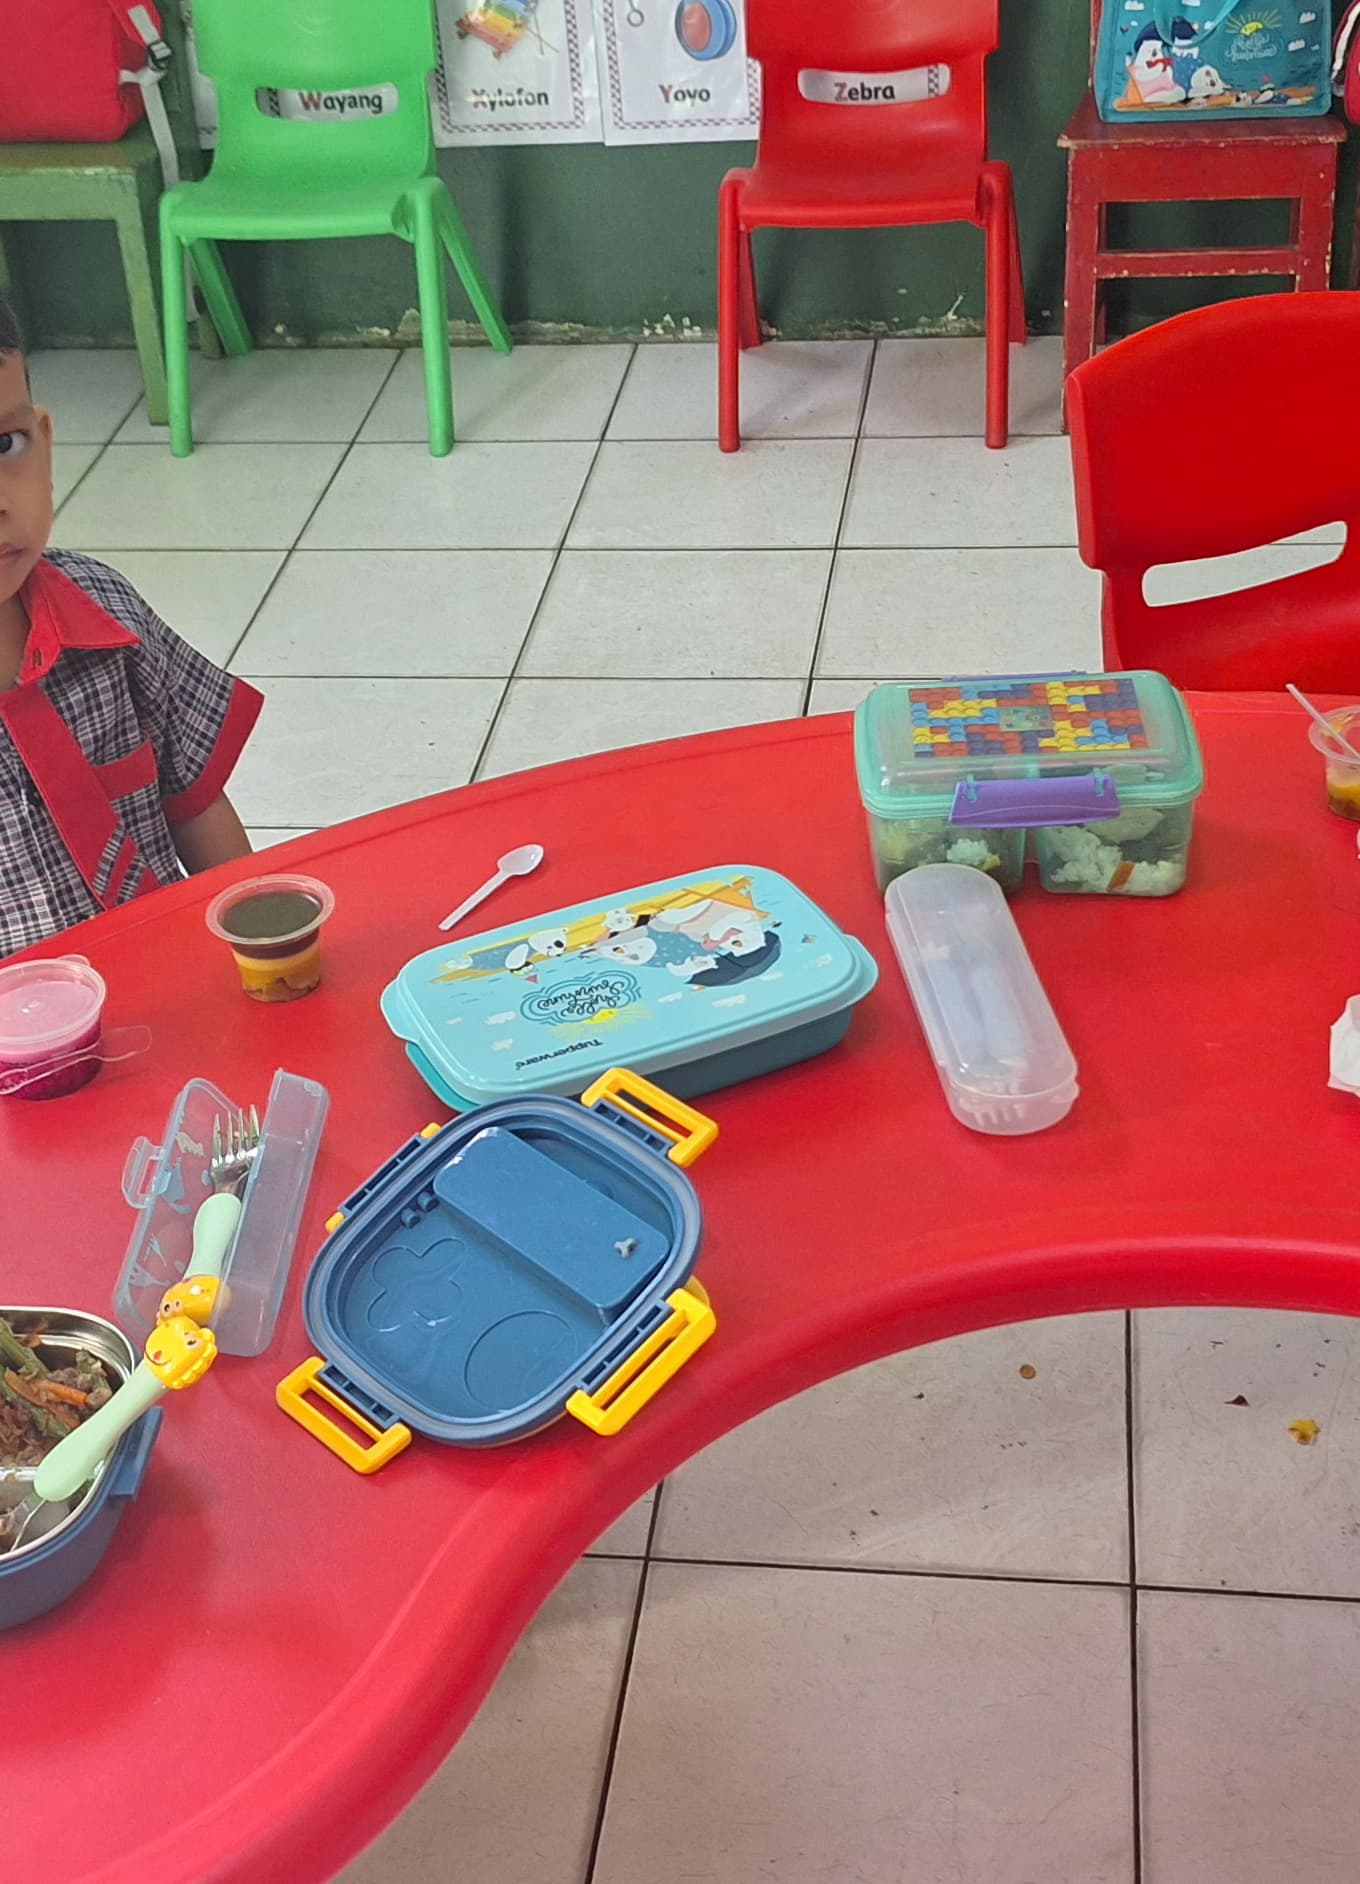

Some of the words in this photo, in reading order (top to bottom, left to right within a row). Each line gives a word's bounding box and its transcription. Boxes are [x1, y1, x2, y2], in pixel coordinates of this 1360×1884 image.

[298, 90, 382, 115] Wayang
[471, 87, 549, 112] Xylofon
[659, 84, 711, 108] Yoyo
[834, 82, 896, 101] Zebra
[515, 1039, 603, 1071] Tupperware
